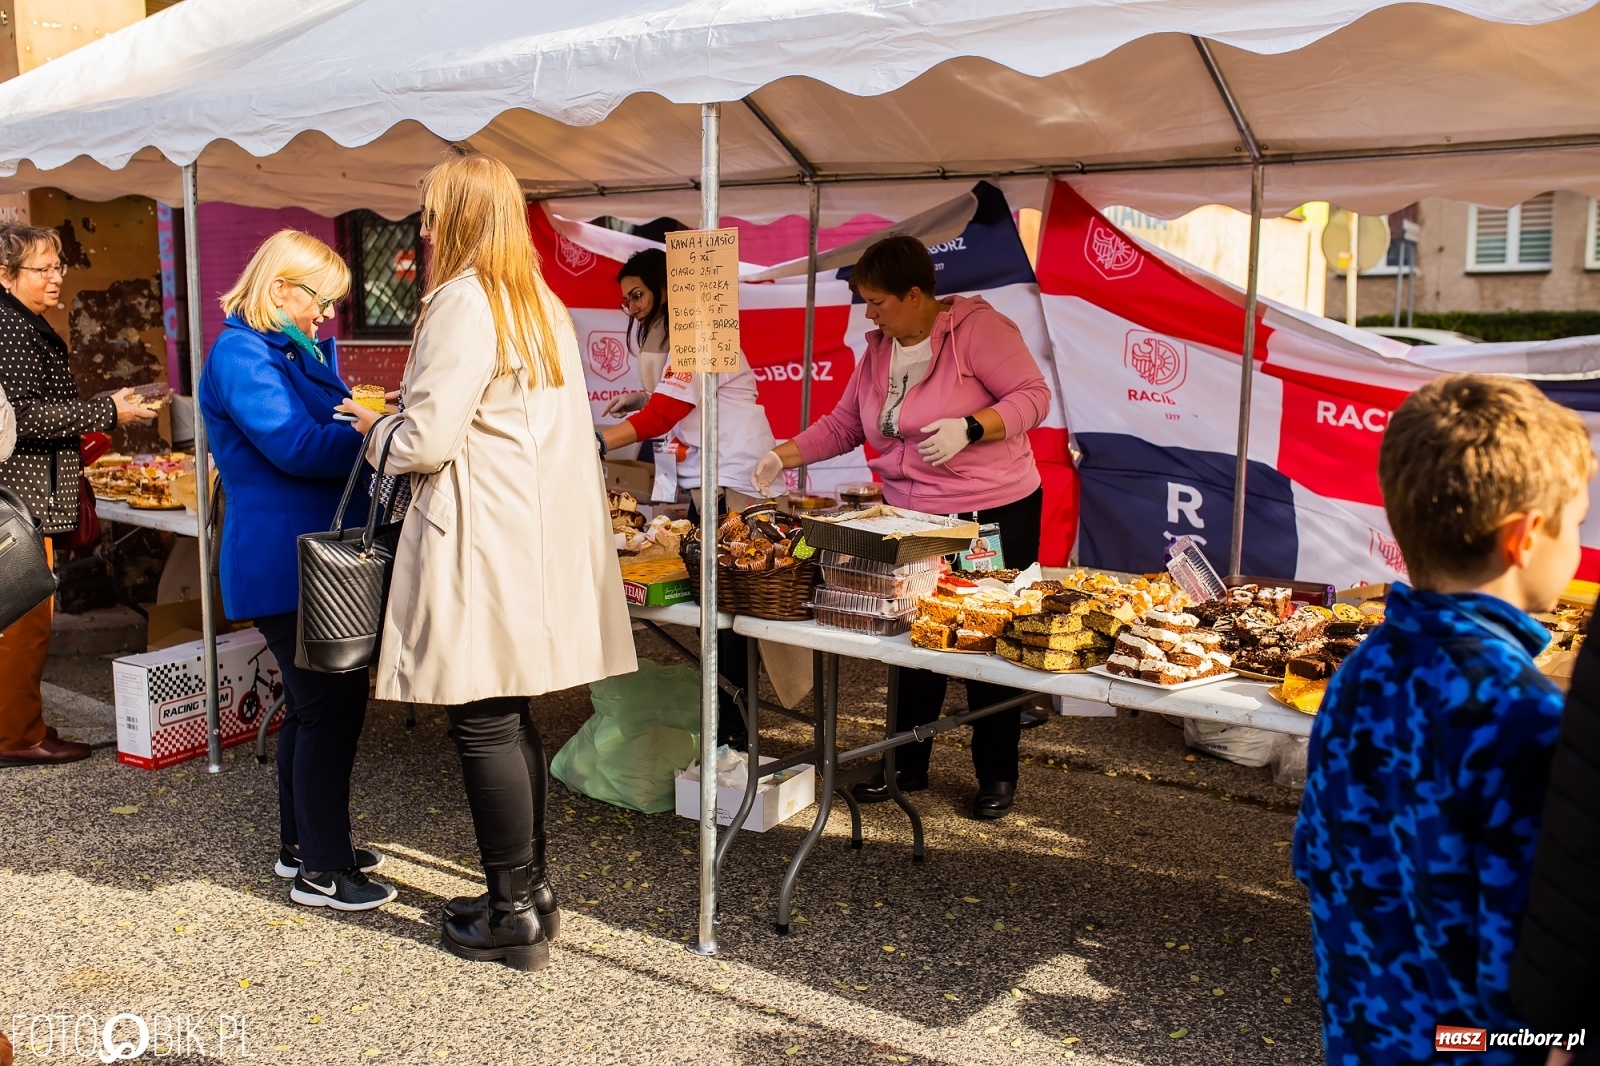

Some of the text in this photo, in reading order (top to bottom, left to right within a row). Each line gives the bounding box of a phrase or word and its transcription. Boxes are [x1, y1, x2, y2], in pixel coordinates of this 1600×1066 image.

[671, 237, 695, 250] KAWA
[705, 234, 735, 247] CIASTO
[689, 252, 697, 264] 5
[670, 267, 695, 277] CIASTO
[672, 280, 729, 292] CIASTO PACZKA
[701, 292, 711, 303] 10
[673, 307, 702, 317] BIGOS
[708, 305, 715, 314] 5
[674, 321, 704, 332] KROKIET
[701, 333, 706, 342] 5
[674, 344, 709, 354] POPCORN
[1167, 481, 1205, 529] R
[623, 585, 645, 603] TELAN
[163, 693, 229, 718] RACING TM
